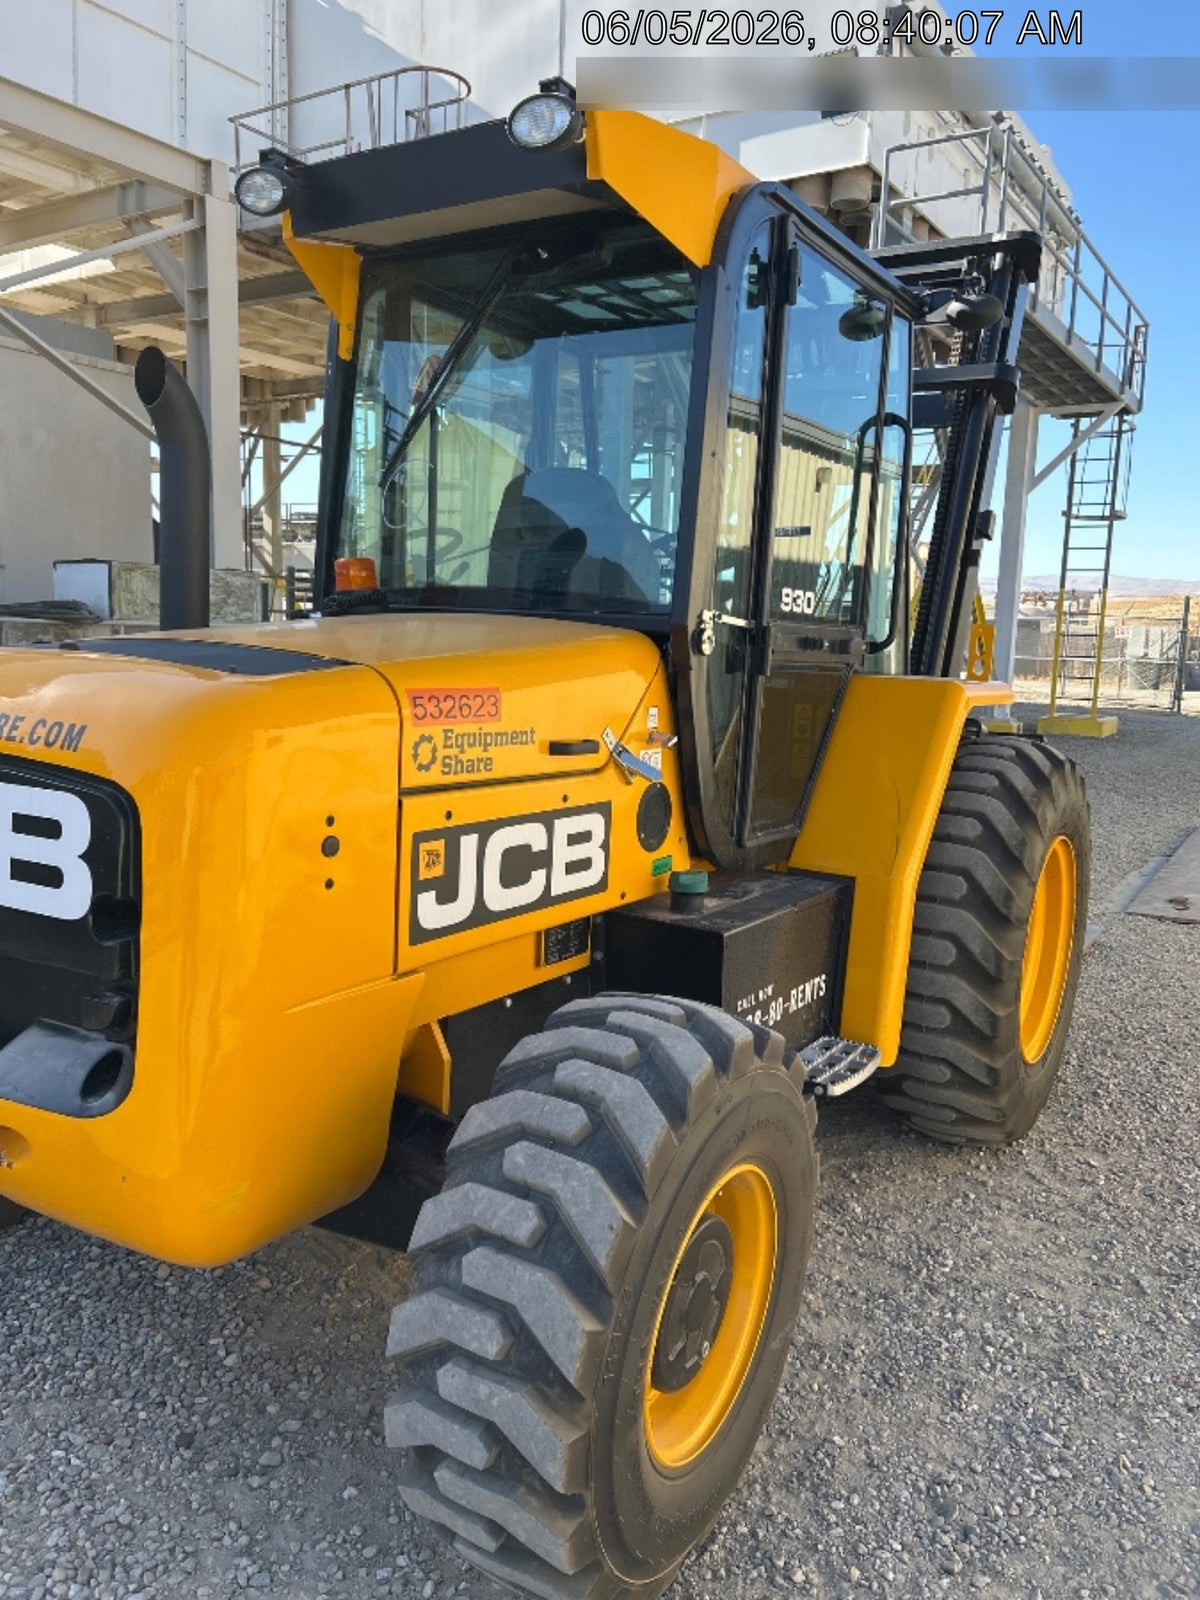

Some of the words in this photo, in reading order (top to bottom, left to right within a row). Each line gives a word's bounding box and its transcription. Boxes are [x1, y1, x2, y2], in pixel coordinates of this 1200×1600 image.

[780, 587, 816, 614] 930
[411, 694, 498, 721] 532623
[442, 727, 536, 753] Equipment
[441, 755, 494, 775] Share
[416, 812, 606, 931] JCB
